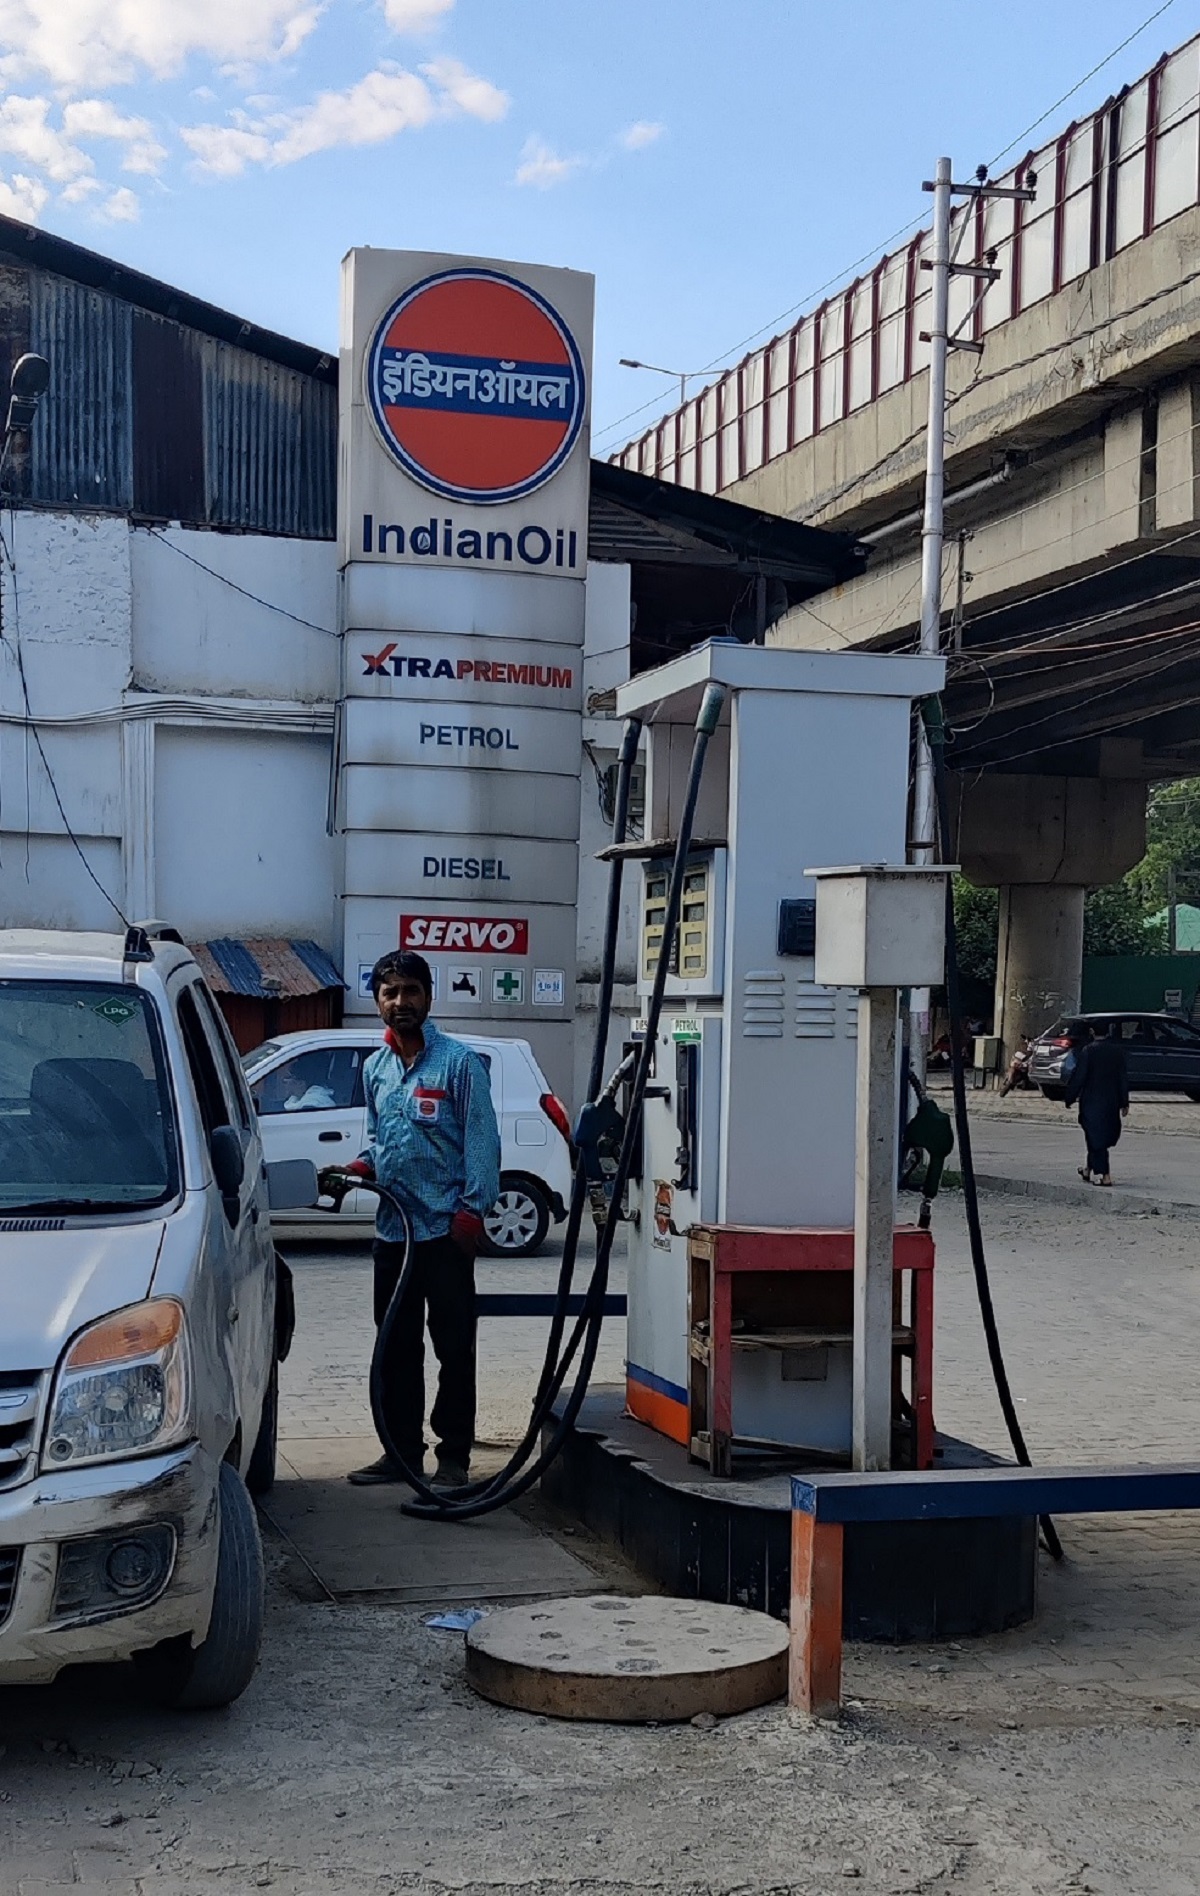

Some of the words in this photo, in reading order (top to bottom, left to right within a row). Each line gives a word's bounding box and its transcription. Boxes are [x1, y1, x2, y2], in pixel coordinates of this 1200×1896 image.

[363, 515, 577, 568] IndianOil
[420, 722, 519, 749] PETROL
[423, 857, 510, 880] DIESEL
[405, 918, 515, 950] SERVO
[104, 1006, 129, 1015] LPG
[675, 1019, 698, 1031] PETROL
